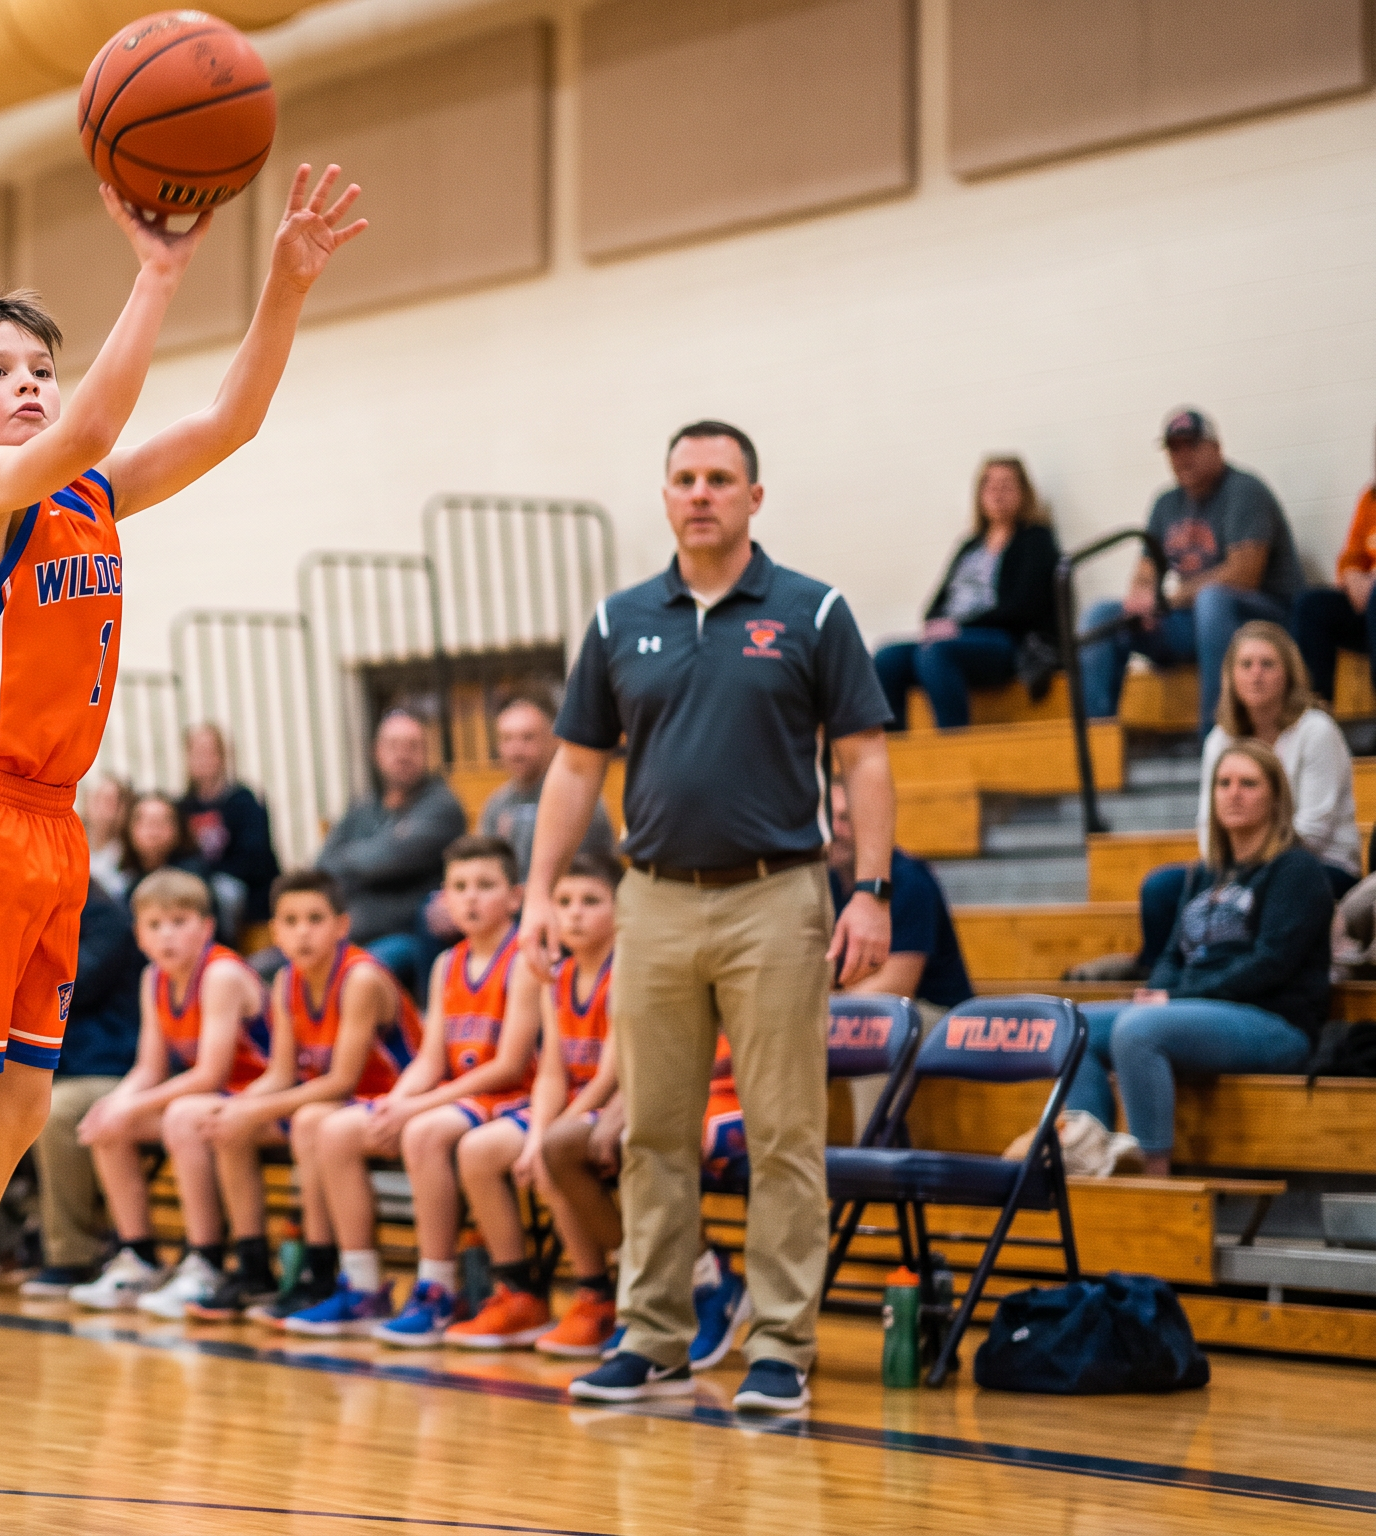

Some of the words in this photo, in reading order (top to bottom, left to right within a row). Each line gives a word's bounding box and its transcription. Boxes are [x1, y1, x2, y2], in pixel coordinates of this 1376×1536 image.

[35, 554, 122, 607] WILDC
[89, 619, 114, 706] 1
[946, 1015, 1056, 1052] WILDCATS
